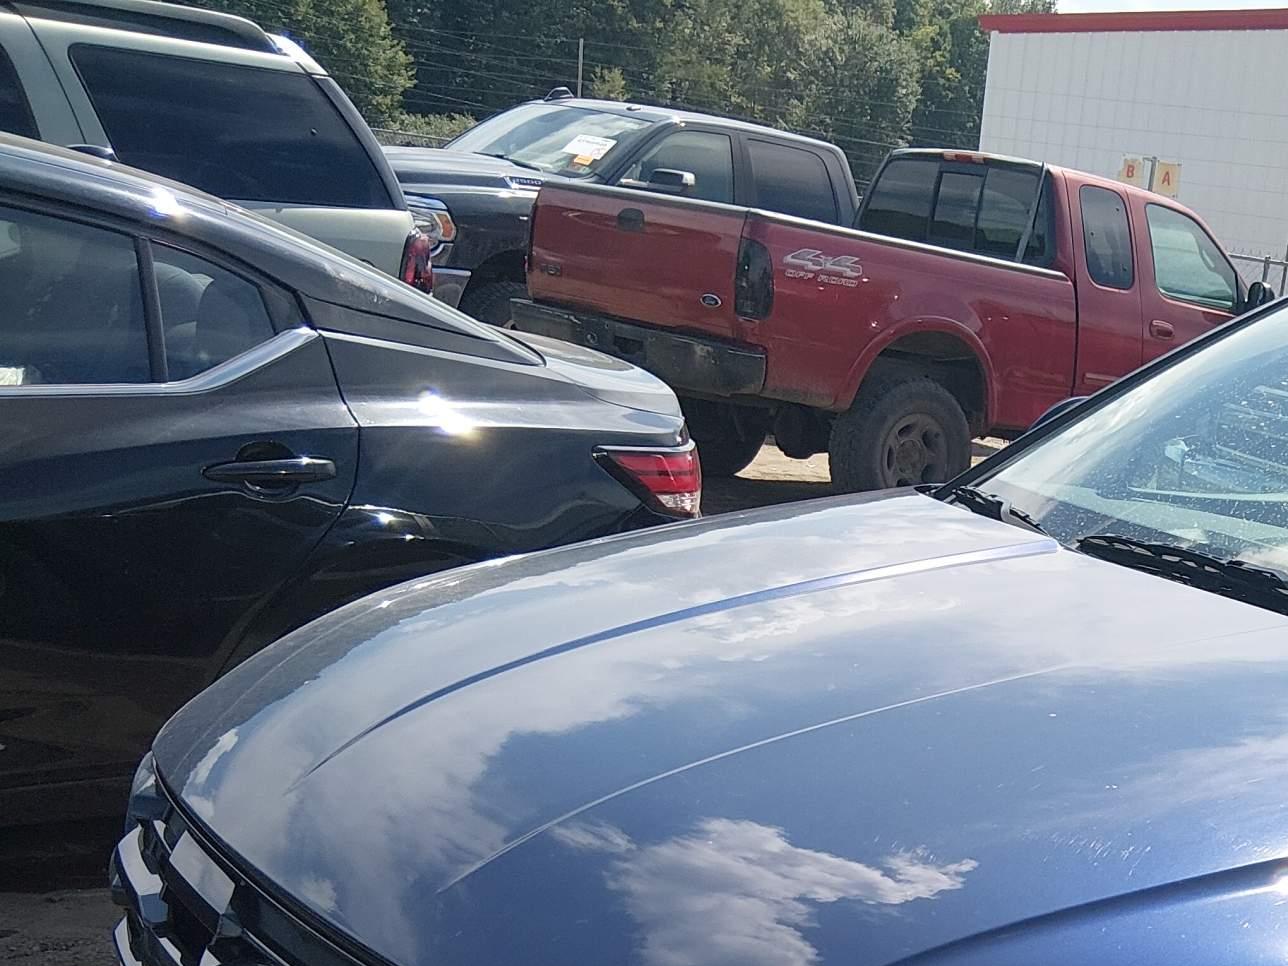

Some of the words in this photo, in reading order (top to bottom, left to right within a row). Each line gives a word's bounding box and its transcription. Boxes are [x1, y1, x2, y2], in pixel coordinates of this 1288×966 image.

[1126, 164, 1136, 178] B
[1161, 171, 1171, 186] A
[785, 268, 815, 280] OFF
[817, 274, 858, 287] ROAD
